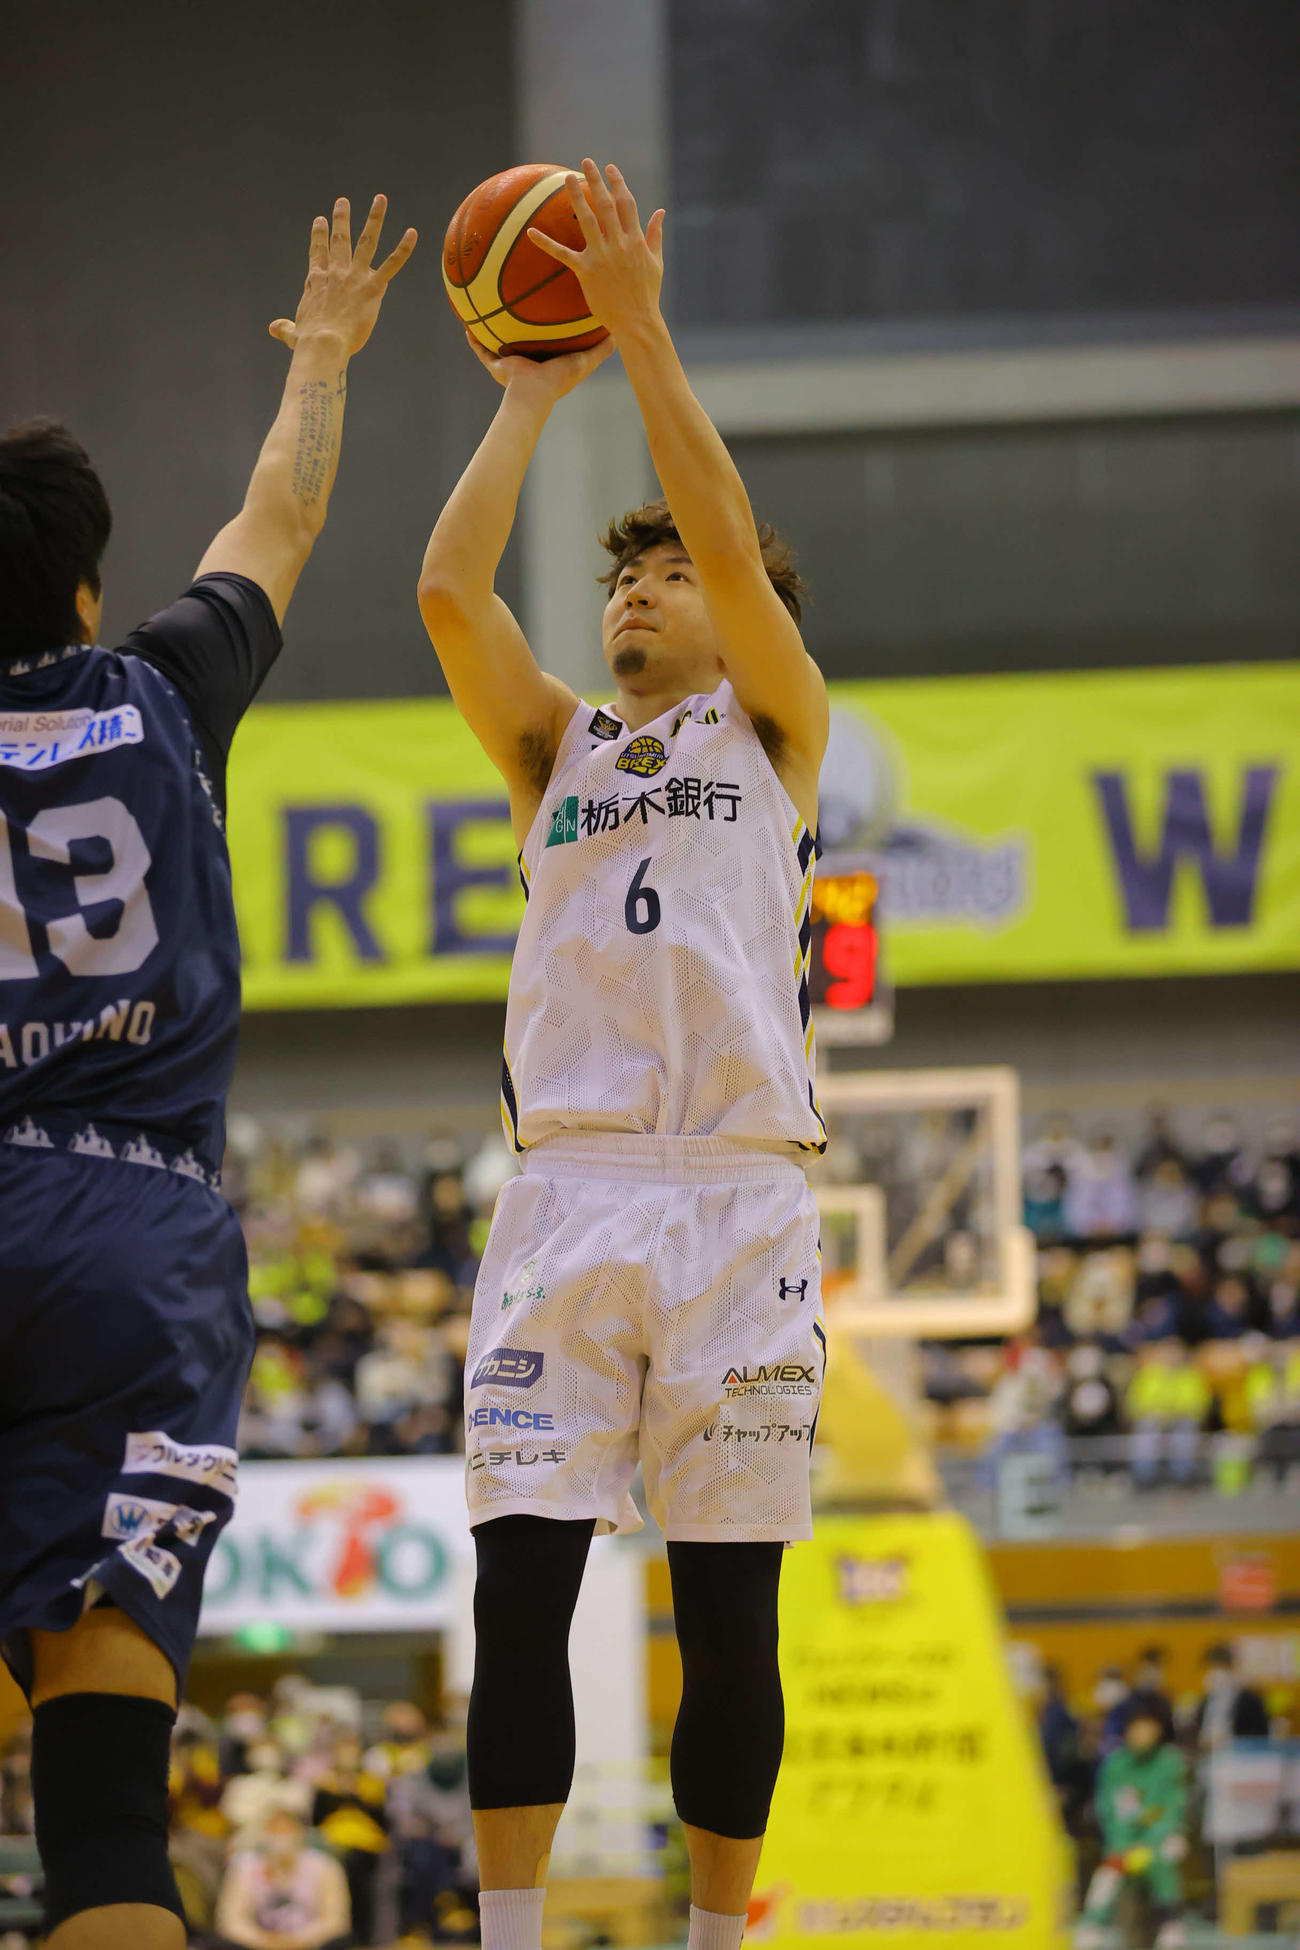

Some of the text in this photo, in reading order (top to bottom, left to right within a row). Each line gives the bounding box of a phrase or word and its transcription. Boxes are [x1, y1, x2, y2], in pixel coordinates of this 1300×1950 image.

[617, 757, 667, 770] BREX
[580, 777, 742, 836] 栃木銀行
[624, 857, 661, 935] 6
[721, 1365, 815, 1385] ALMEX
[725, 1385, 812, 1399] TECHNOLOGIES
[472, 1449, 566, 1471] ニチレキ
